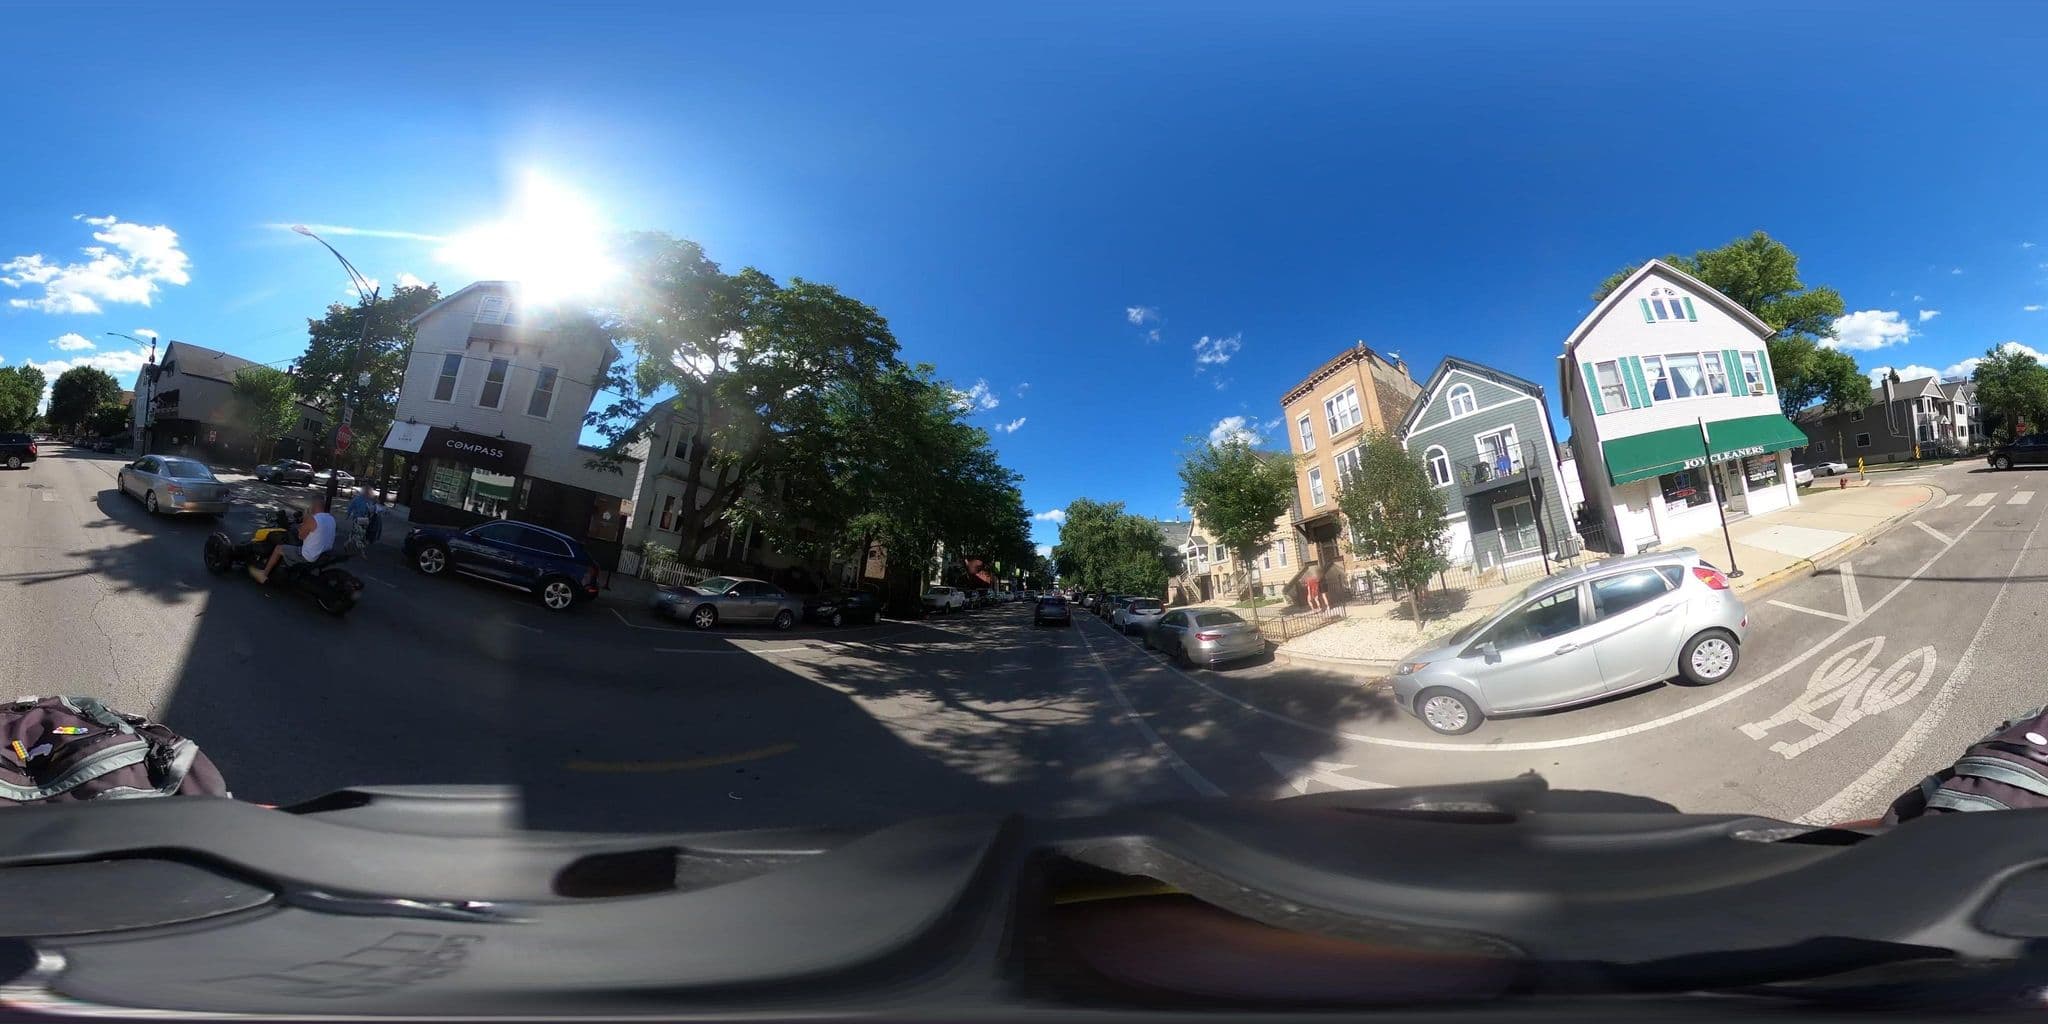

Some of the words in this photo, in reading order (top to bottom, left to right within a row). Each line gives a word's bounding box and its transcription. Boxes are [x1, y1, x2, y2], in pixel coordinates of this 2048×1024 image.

[446, 439, 504, 458] COMPASS
[1683, 456, 1706, 470] JOY
[1710, 445, 1765, 463] CLEANERS
